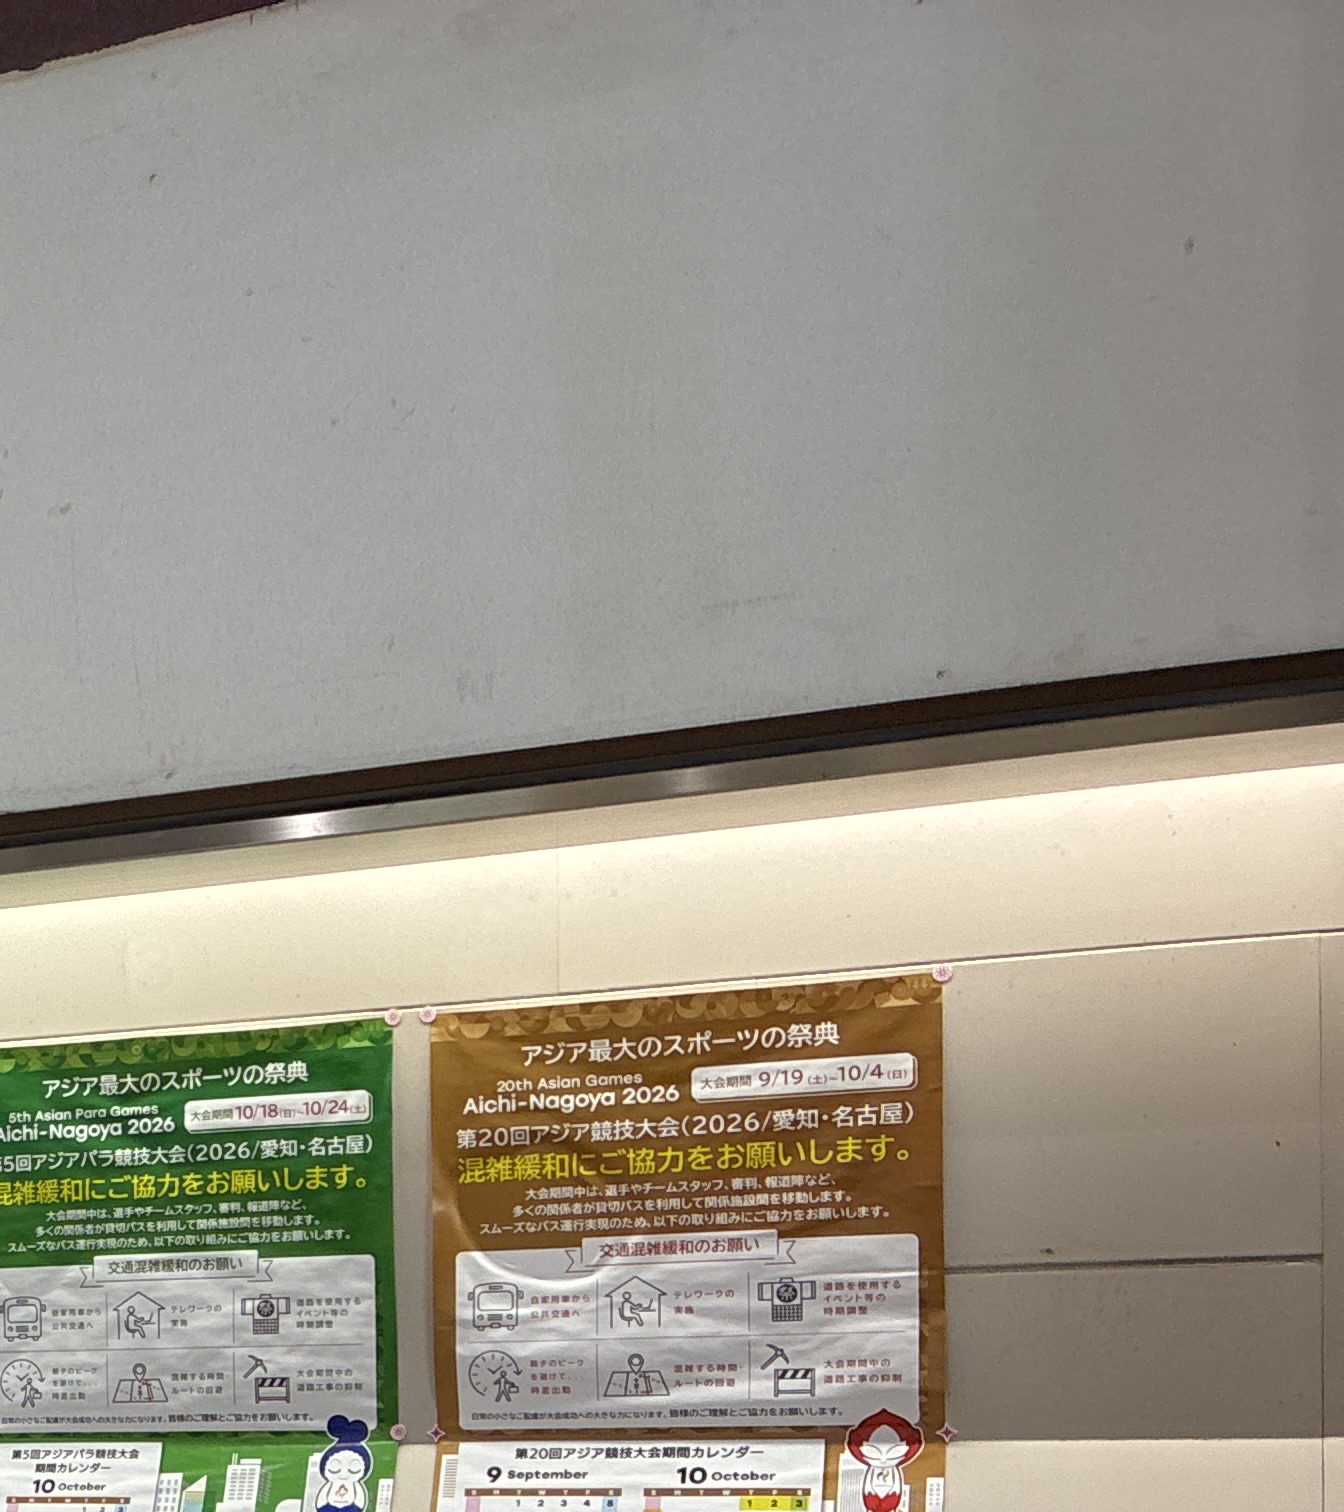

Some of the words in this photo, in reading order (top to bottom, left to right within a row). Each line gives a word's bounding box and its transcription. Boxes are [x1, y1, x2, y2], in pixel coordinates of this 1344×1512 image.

[521, 1021, 840, 1067] アジア最大のスポーツの祭典
[42, 1061, 309, 1098] アジア最大のスポーツの祭典
[497, 1080, 532, 1092] 20th
[537, 1076, 581, 1090] Asian
[585, 1073, 642, 1086] Games
[700, 1075, 751, 1089] 大会期間
[463, 1090, 615, 1115] Aichi-Nagoya
[622, 1085, 680, 1105] 2026
[8, 1112, 31, 1123] 5th
[35, 1109, 72, 1122] Asian
[75, 1107, 107, 1119] Para
[110, 1104, 159, 1117] Games
[191, 1108, 234, 1122] 大会期間
[128, 1117, 176, 1134] 2026
[457, 1134, 910, 1184] 混雑緩和にご協力をお願いします。
[599, 1237, 760, 1259] 交通混雑緩和のお願い
[108, 1257, 243, 1275] 交通混雑緩和のお願い
[12, 1449, 140, 1460] 第5回アジアパラ競技大会
[515, 1446, 764, 1459] 第20回アジア競技大会期間カレンダー
[35, 1463, 111, 1473] 期間カレンダー
[487, 1466, 502, 1483] 9
[508, 1470, 588, 1481] September
[677, 1467, 708, 1484] 10
[712, 1471, 776, 1481] October
[33, 1479, 55, 1493] 10
[58, 1482, 106, 1491] October
